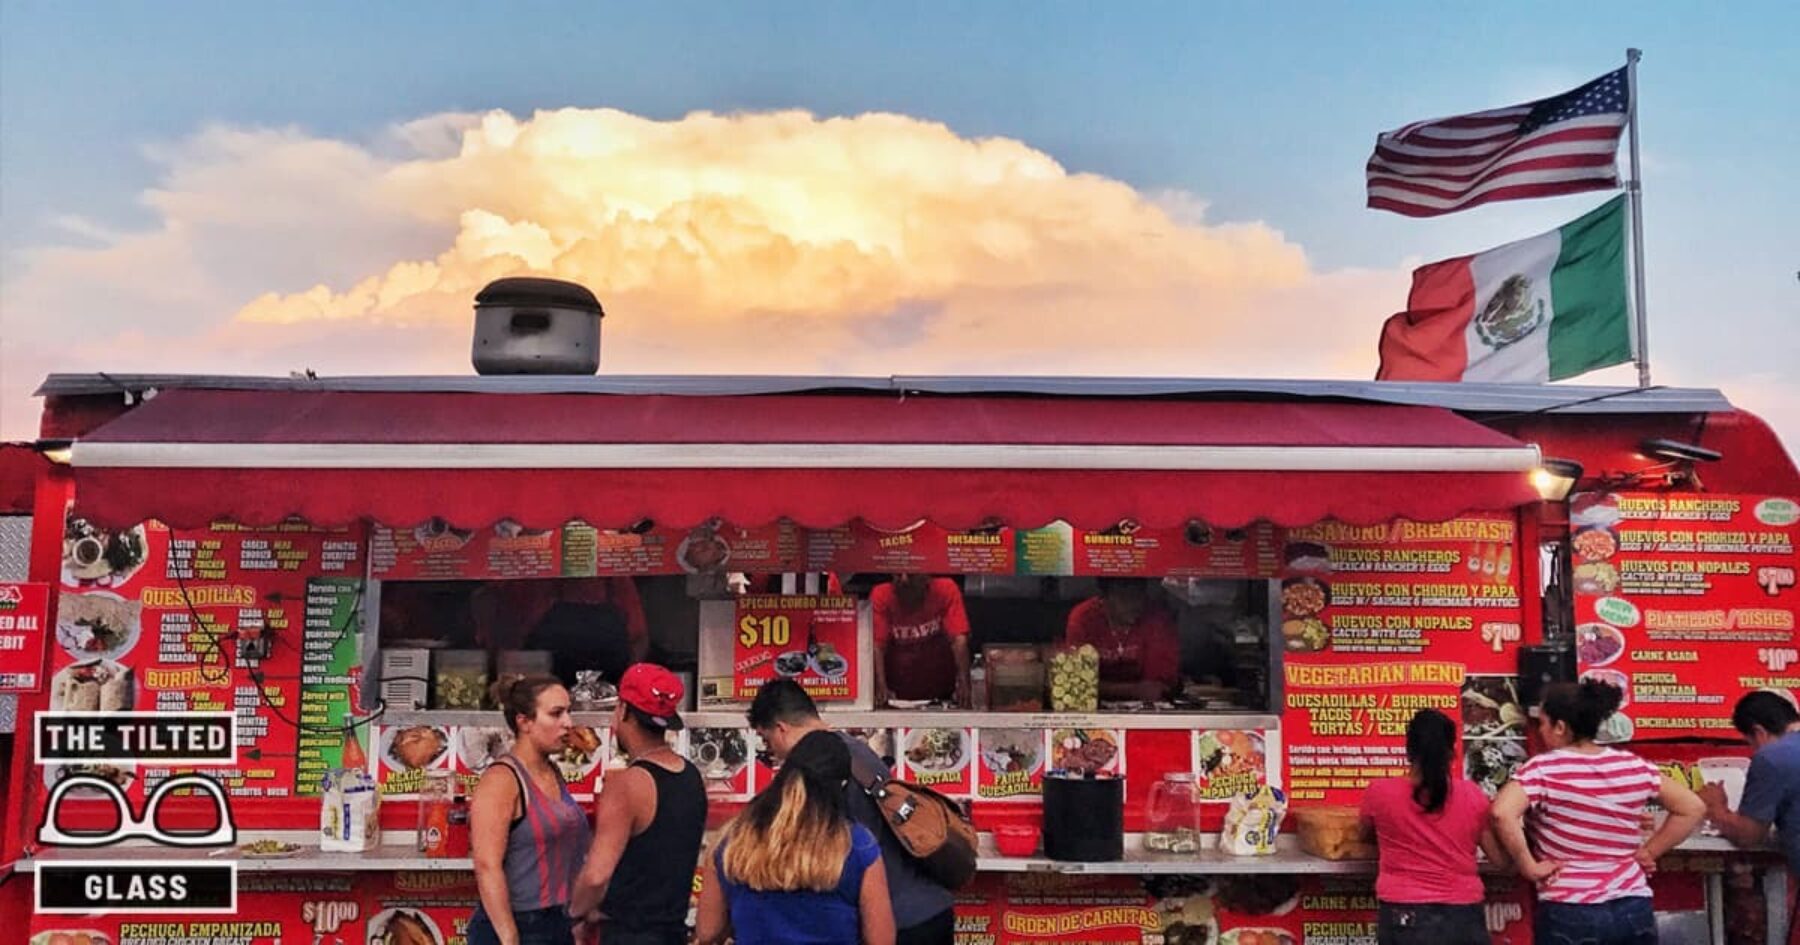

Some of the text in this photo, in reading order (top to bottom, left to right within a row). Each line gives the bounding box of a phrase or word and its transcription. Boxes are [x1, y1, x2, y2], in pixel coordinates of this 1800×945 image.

[1619, 500, 1740, 512] HUEVOS RANCHEROS
[1403, 521, 1513, 541] BREAKFAST
[1620, 531, 1667, 542] HUEVOS
[1670, 531, 1693, 543] CON
[1697, 532, 1746, 543] CHORIZO
[1760, 533, 1790, 544] PAPA
[879, 534, 912, 548] TACOS
[947, 535, 1001, 544] QUESADILLAS
[1084, 535, 1133, 545] BURRITOS
[1331, 550, 1460, 563] HUEVOS RANCHEROS
[1621, 561, 1751, 573] HUEVOS CON NOPALES
[142, 587, 254, 606] QUESADILLAS
[1331, 583, 1516, 597] HUEVOS CON CHORIZO Y PAPA
[740, 597, 778, 608] SPECIAL
[780, 597, 817, 608] COMBO
[17, 616, 38, 630] ALL
[1332, 615, 1473, 629] HUEVOS CON NOPALES
[1647, 611, 1793, 628] PLATILLOS DISHES
[740, 614, 790, 648] $10
[1631, 651, 1699, 661] CARNE ASADA
[147, 670, 230, 688] BURRITOS
[1288, 665, 1464, 685] VEGETARIAN MENU
[1632, 673, 1677, 683] PECHUGA
[1738, 677, 1766, 687] TRES
[1633, 685, 1697, 695] EMPANIZADA
[1287, 695, 1377, 708] QUESADILLAS
[1391, 695, 1457, 707] BURRITOS
[1310, 708, 1353, 721] TACOS
[1310, 722, 1364, 735] TORTAS
[1378, 723, 1409, 735] CEM
[1636, 718, 1697, 728] ENCHILADAS
[386, 768, 426, 781] MEXICA
[914, 772, 962, 785] TOSTADA
[993, 771, 1030, 784] FAJITA
[1208, 773, 1257, 787] PECHUGA
[979, 784, 1042, 797] QUESADILLA
[1303, 897, 1347, 909] CARNE
[1007, 913, 1057, 933] ORDEN
[1060, 914, 1081, 930] DE
[1083, 909, 1159, 928] CARNITAS
[120, 923, 282, 938] PECHUGA EMPANIZADA
[1304, 923, 1363, 936] PECHUGA
